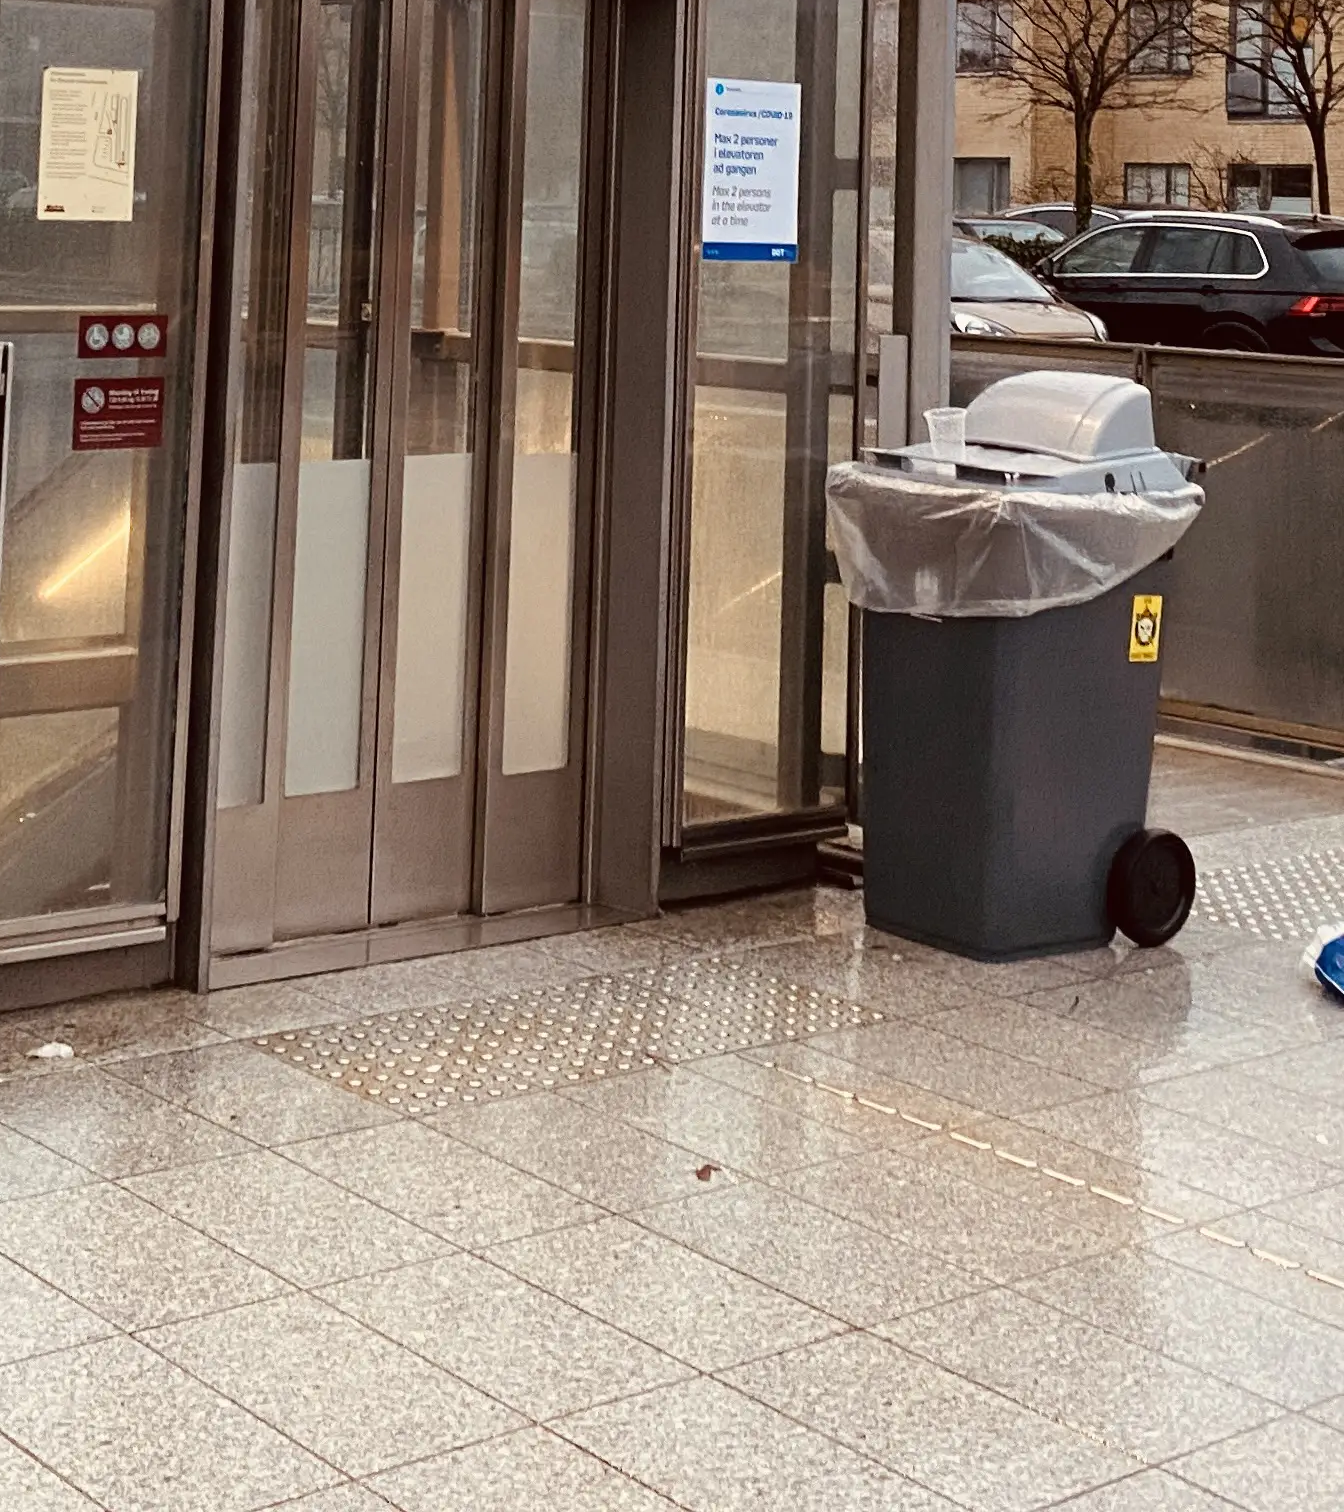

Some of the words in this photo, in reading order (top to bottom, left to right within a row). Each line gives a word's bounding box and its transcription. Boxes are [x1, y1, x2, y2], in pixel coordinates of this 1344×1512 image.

[714, 133, 732, 145] Max
[733, 134, 740, 144] 2
[740, 135, 778, 148] personer
[718, 148, 764, 160] elevatoren
[713, 163, 724, 174] ad
[725, 166, 757, 178] gangen
[712, 185, 730, 197] Max
[731, 186, 738, 197] 2
[738, 188, 772, 200] persons
[712, 199, 720, 212] in
[721, 200, 735, 212] the
[736, 200, 772, 213] elevator
[711, 215, 721, 226] at
[729, 215, 749, 227] time
